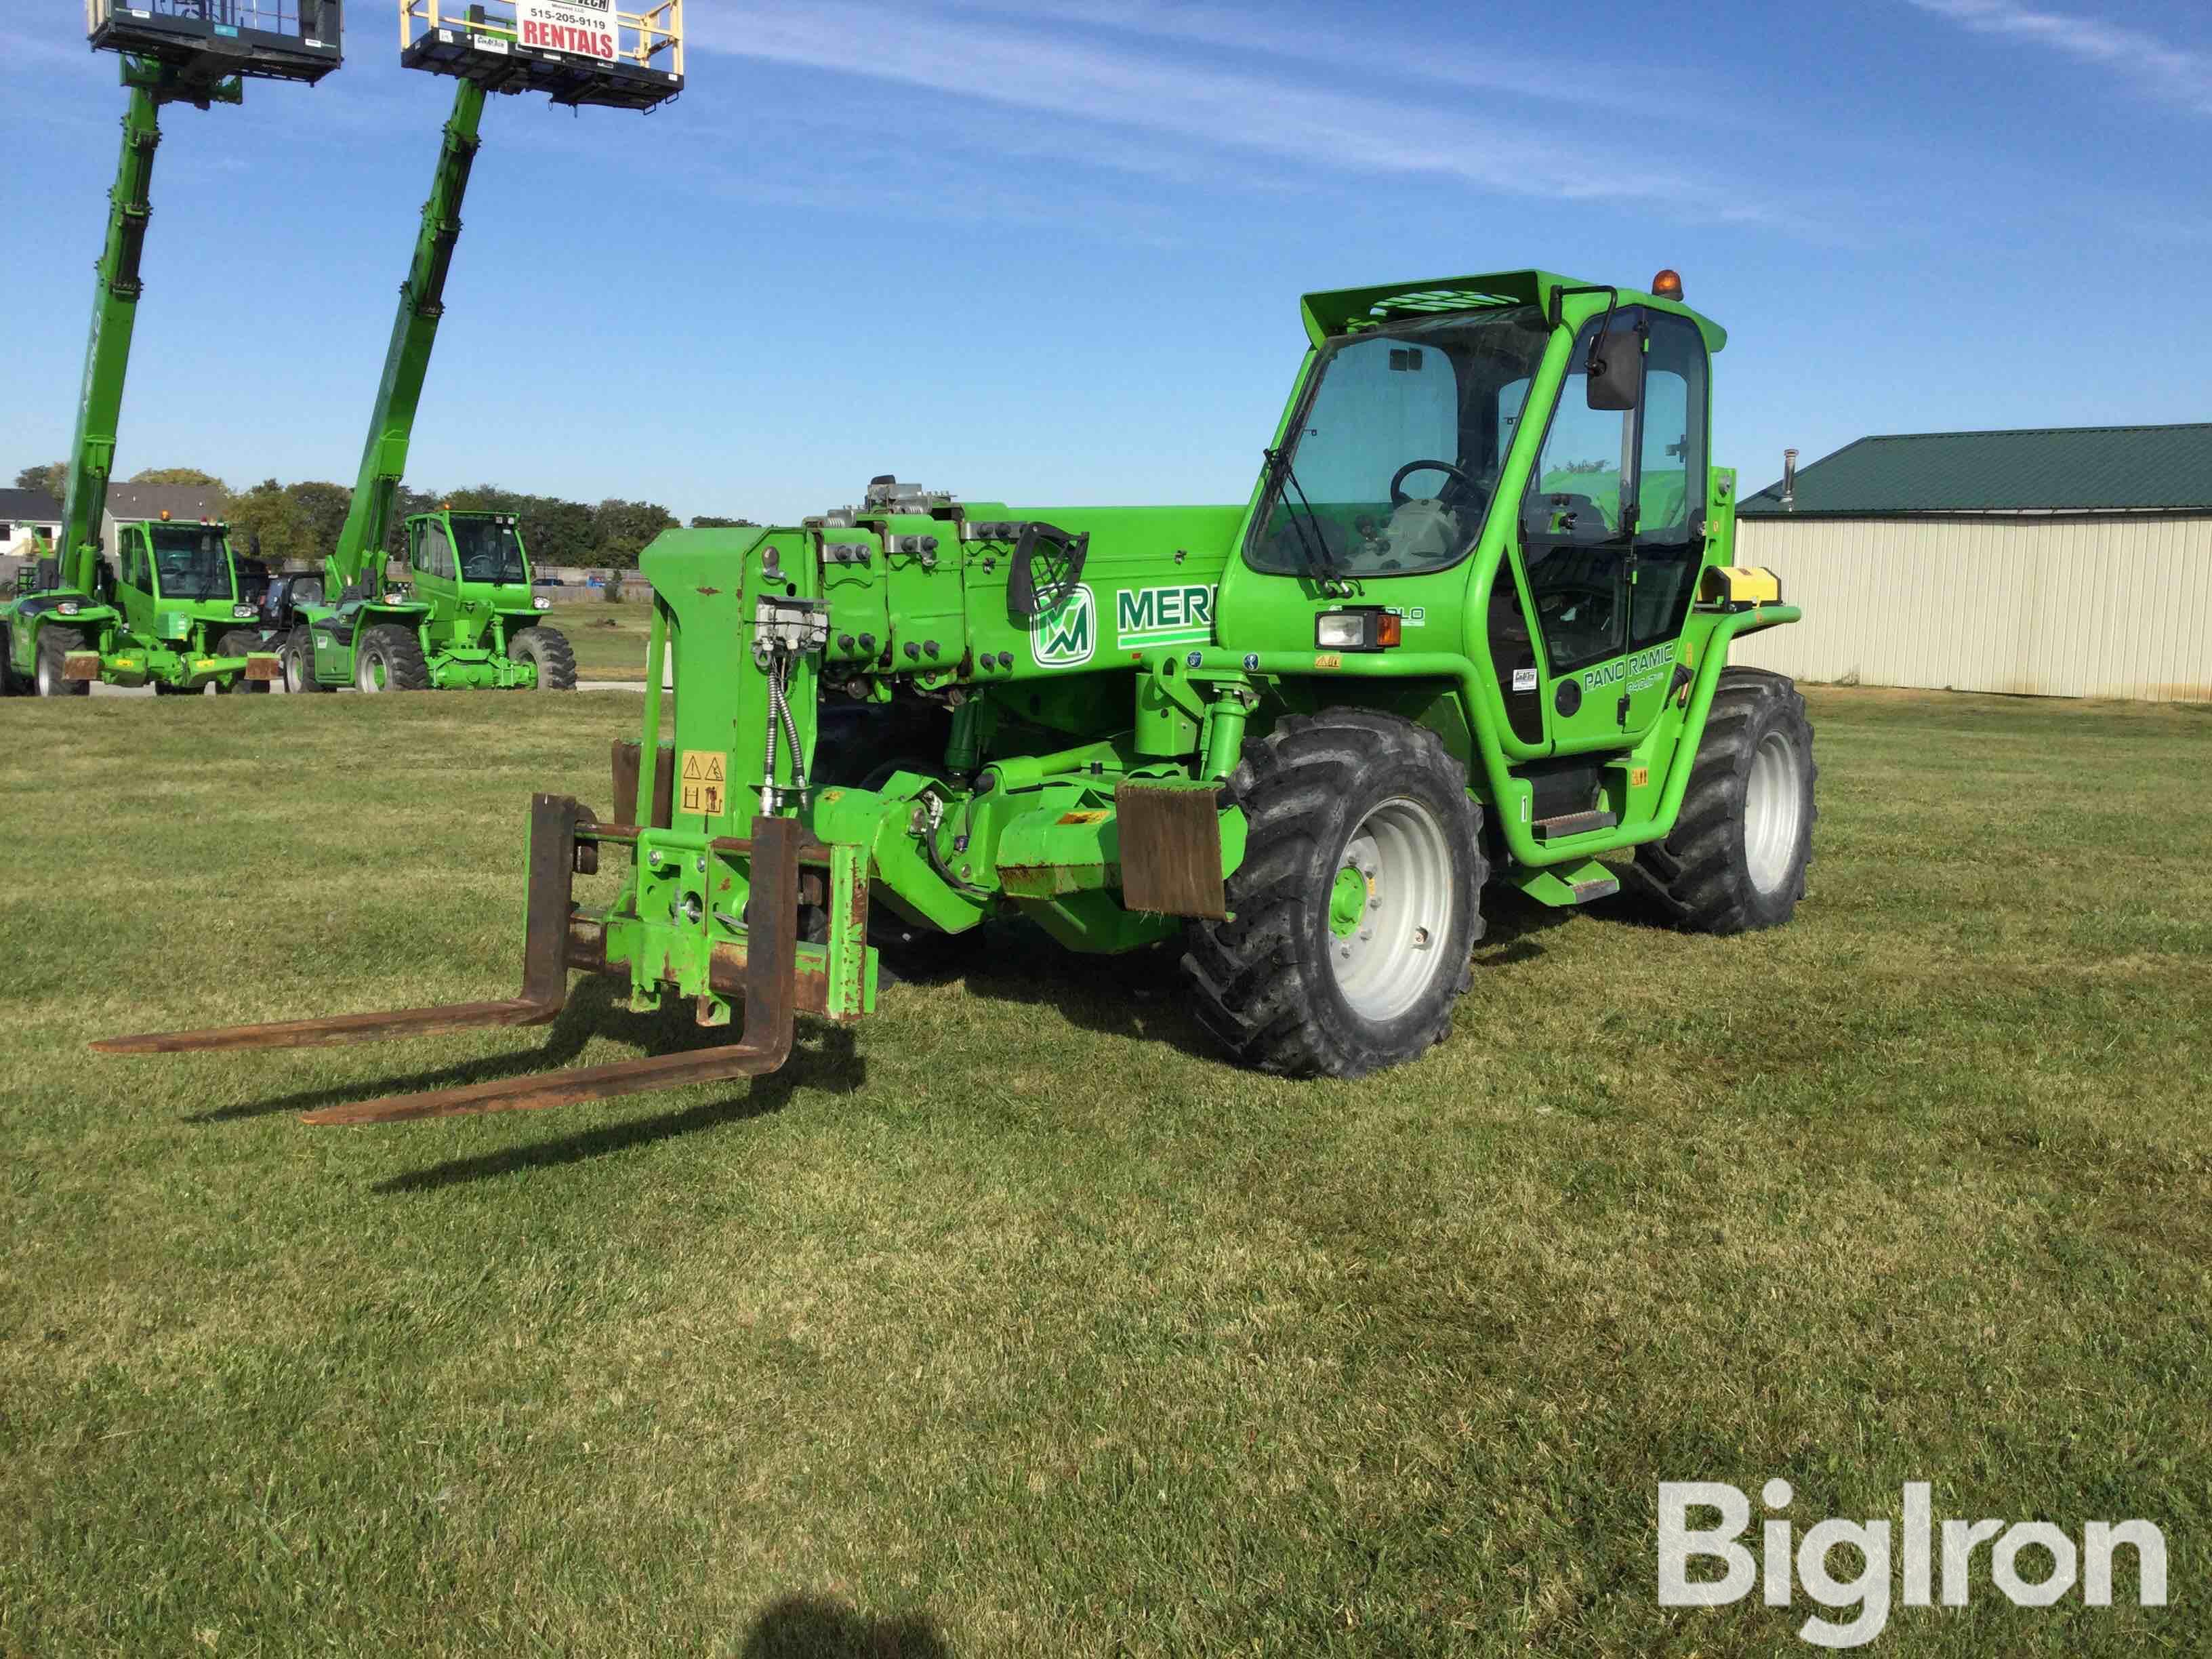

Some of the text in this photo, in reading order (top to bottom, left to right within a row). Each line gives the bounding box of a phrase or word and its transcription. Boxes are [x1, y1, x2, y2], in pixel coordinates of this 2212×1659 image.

[531, 7, 606, 30] 515-205-9119
[523, 20, 613, 59] RENTALS
[1118, 585, 1218, 631] MER
